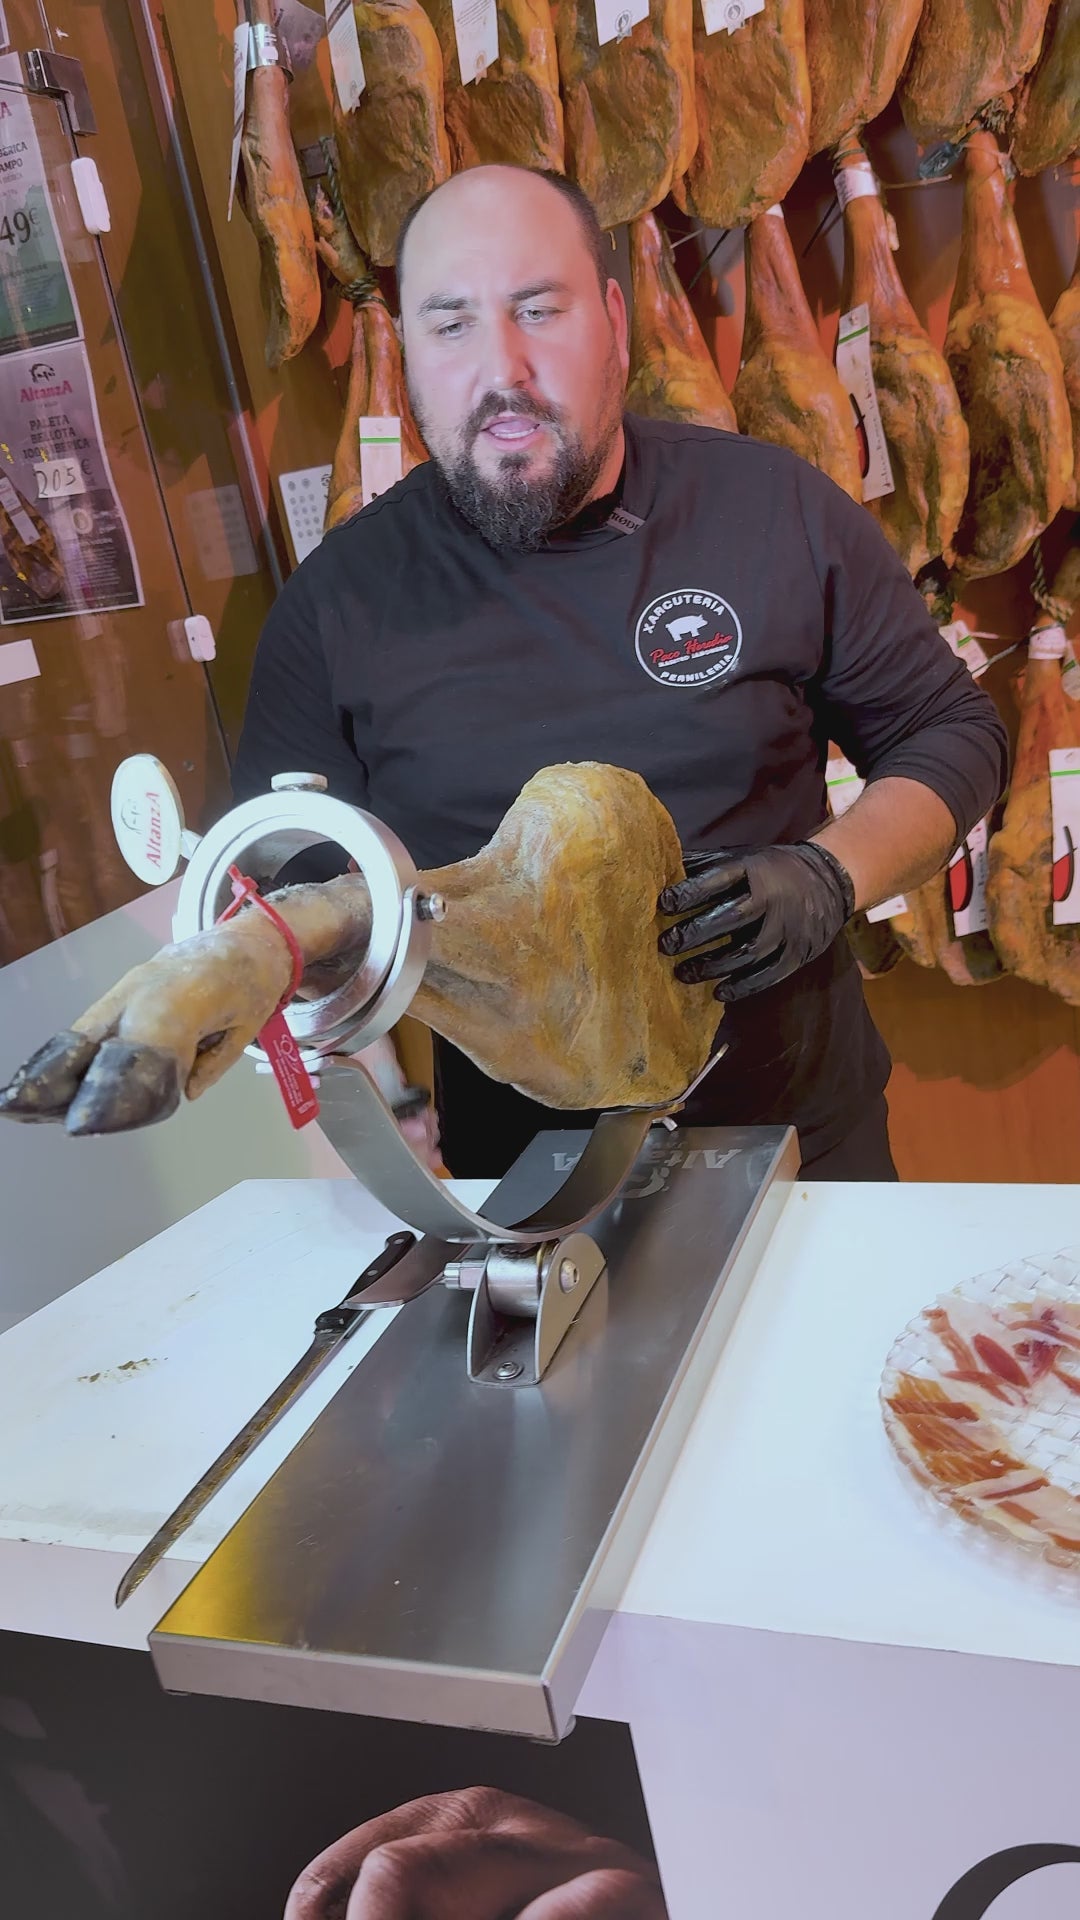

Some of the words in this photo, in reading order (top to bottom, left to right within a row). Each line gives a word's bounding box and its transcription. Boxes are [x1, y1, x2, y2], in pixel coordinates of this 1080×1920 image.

[20, 380, 73, 402] AltanzA
[33, 467, 76, 496] 205
[650, 648, 680, 663] Paco
[145, 792, 161, 868] AltanzA
